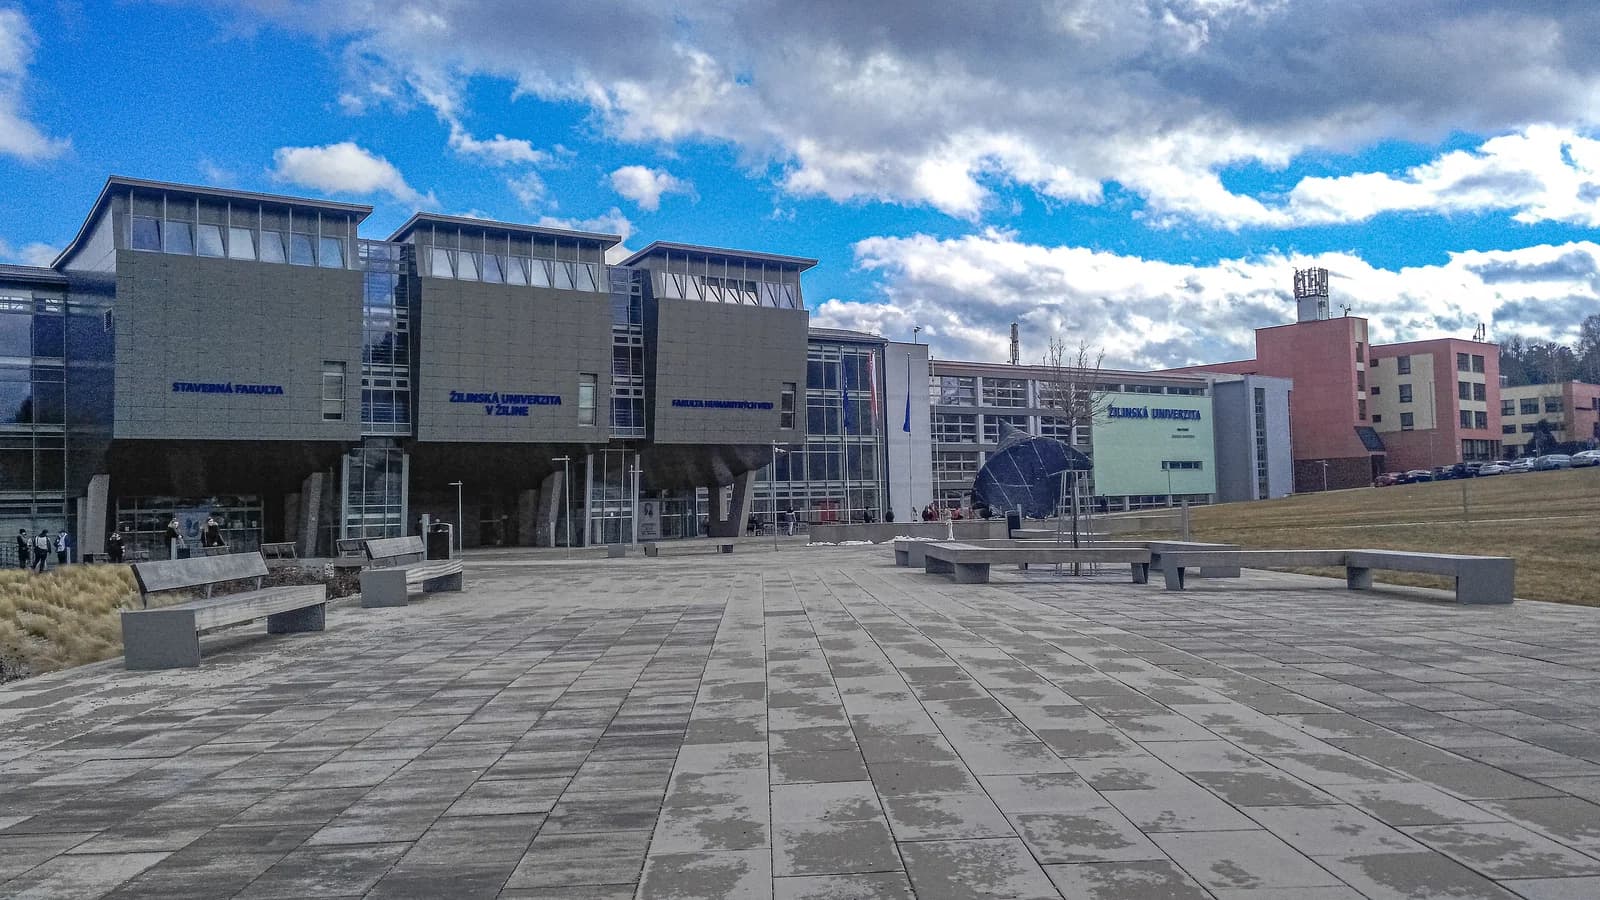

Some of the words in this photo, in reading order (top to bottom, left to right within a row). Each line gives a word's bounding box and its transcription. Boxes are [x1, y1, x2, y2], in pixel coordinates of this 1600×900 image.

[172, 382, 233, 393] STAVEBNÁ
[235, 384, 283, 394] FAKULTA
[449, 390, 499, 403] ŽILINSKÁ
[502, 394, 561, 405] UNIVERZITA
[672, 399, 704, 408] FAKULTA
[485, 405, 494, 415] V
[496, 404, 529, 416] ŽILINE
[1108, 405, 1149, 418] ŽILINSKÁ
[1151, 408, 1201, 420] UNIVERZITA
